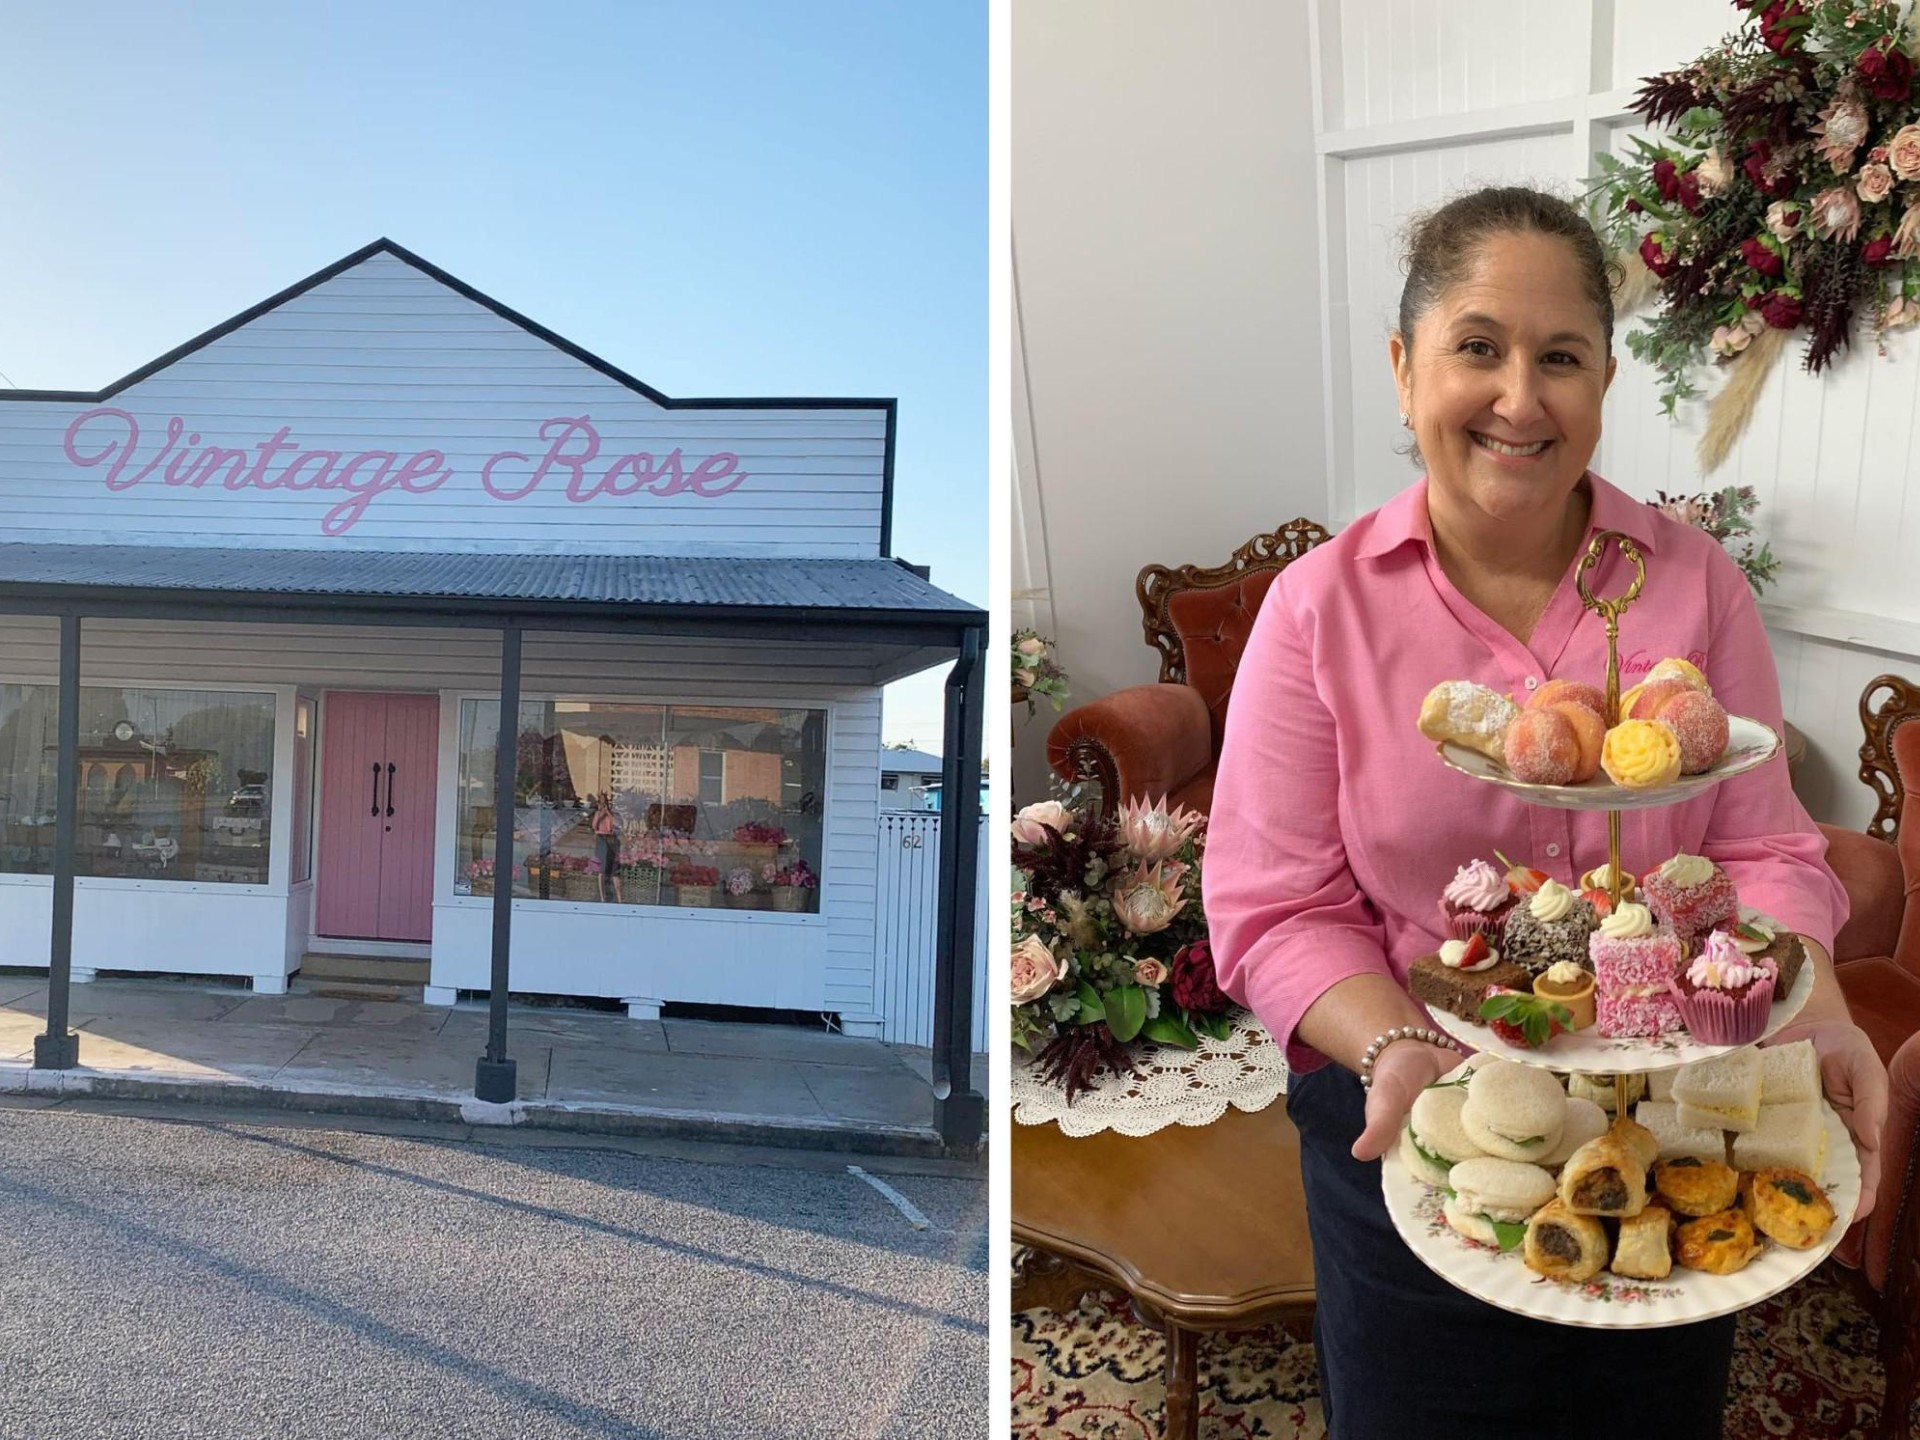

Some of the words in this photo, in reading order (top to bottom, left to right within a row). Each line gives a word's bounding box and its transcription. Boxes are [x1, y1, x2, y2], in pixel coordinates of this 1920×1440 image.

[64, 407, 453, 536] Vintage
[482, 414, 748, 503] Rose
[1604, 649, 1659, 675] Vint
[902, 834, 922, 849] 62
